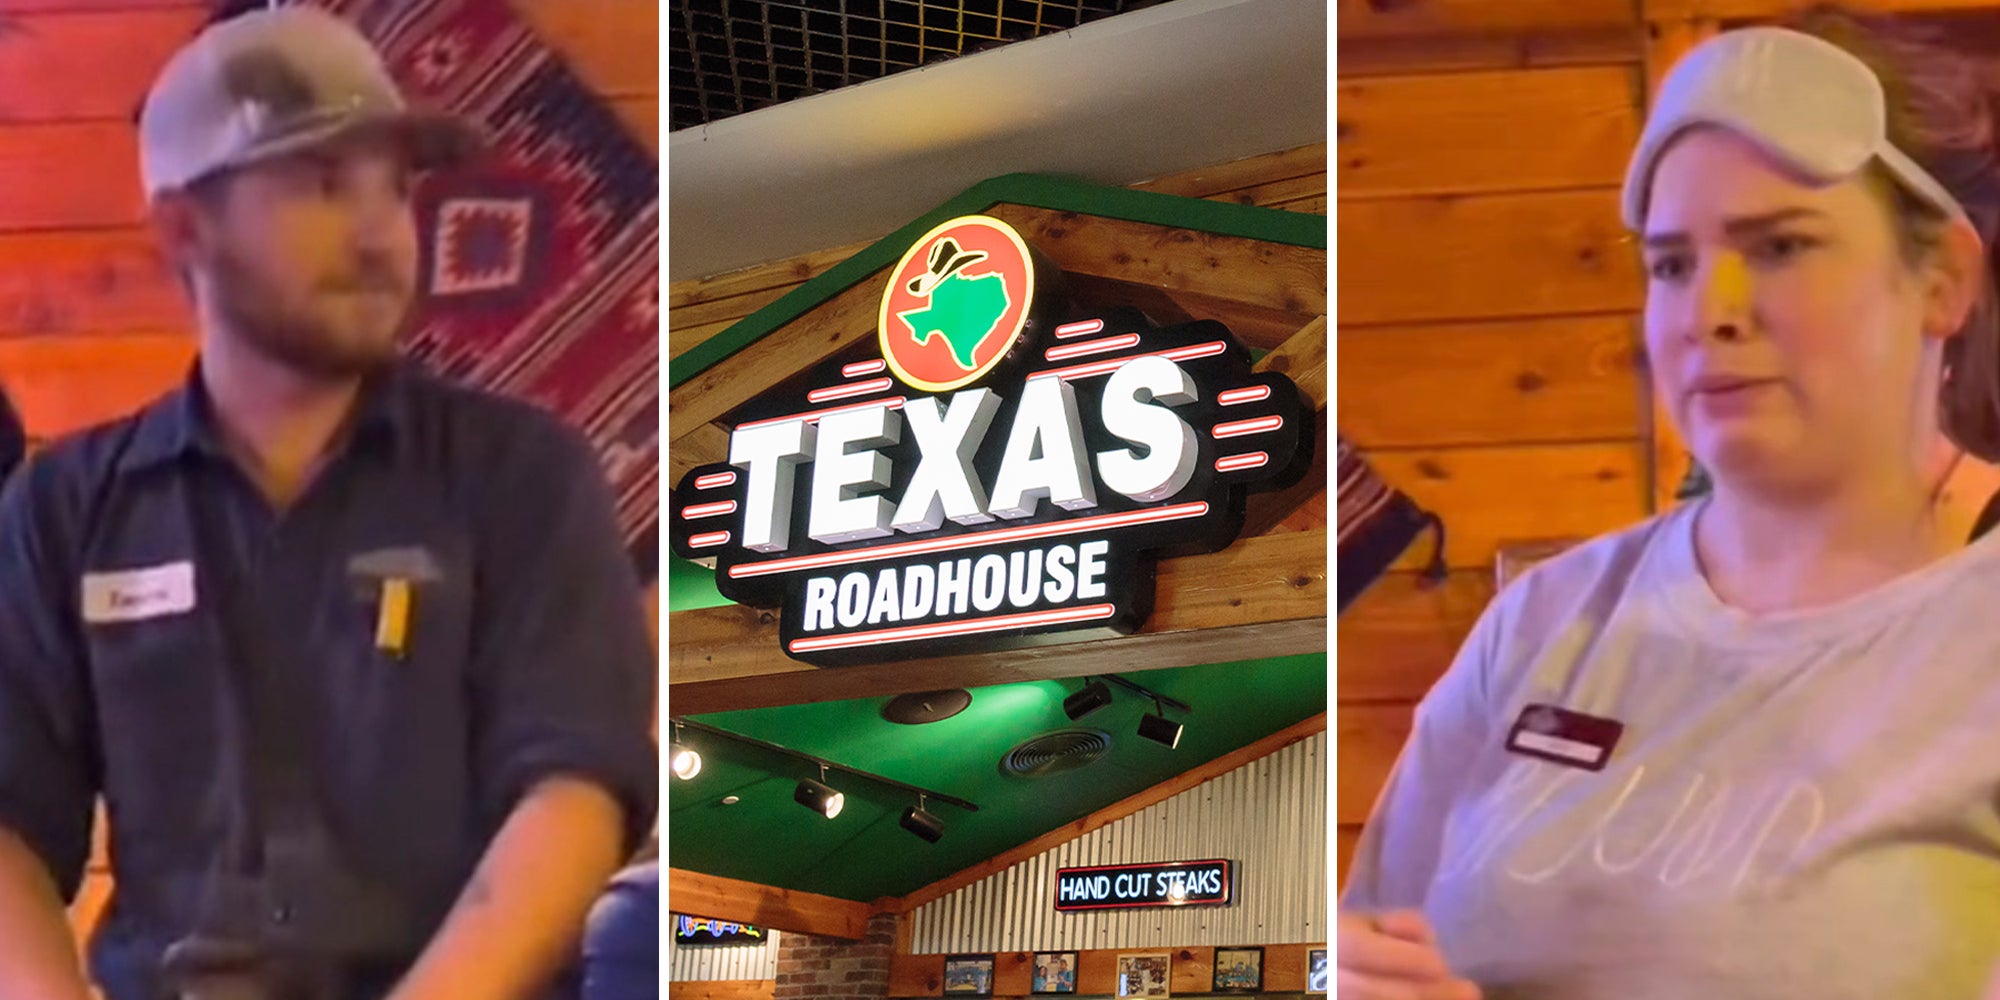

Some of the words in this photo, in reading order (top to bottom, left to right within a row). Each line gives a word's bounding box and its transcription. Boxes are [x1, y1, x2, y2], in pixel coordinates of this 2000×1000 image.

[729, 355, 1199, 553] TEXAS
[802, 539, 1109, 632] ROADHOUSE
[1060, 875, 1110, 901] HAND
[1115, 873, 1152, 898] CUT
[1156, 868, 1221, 897] STEAKS
